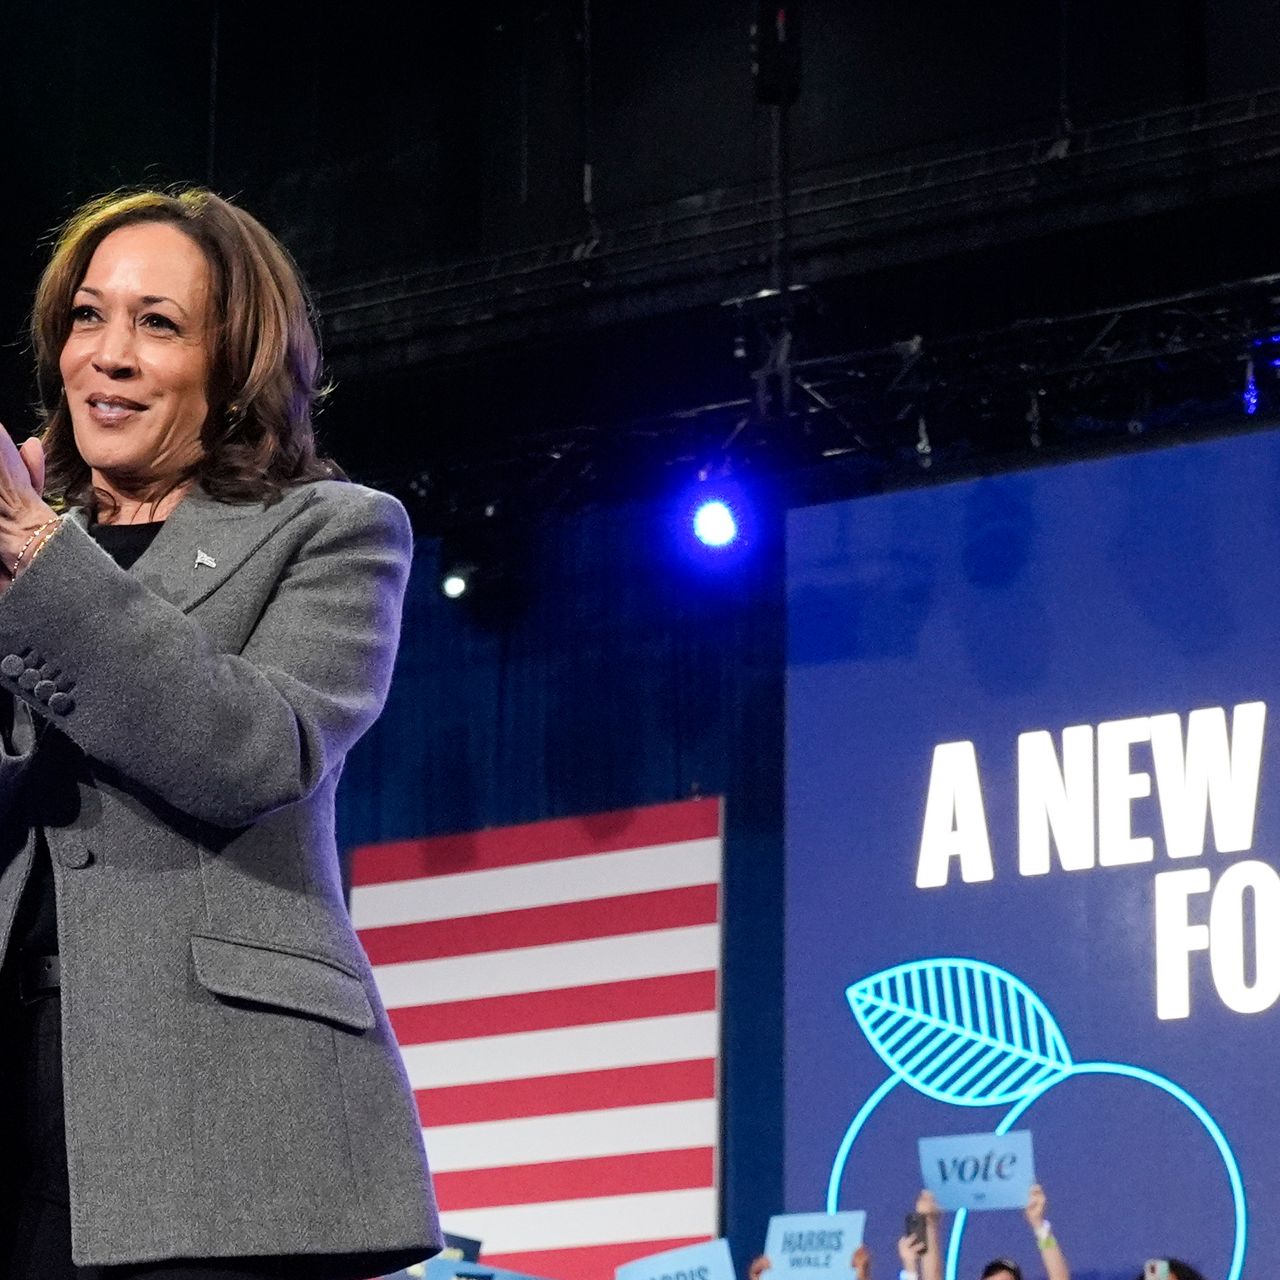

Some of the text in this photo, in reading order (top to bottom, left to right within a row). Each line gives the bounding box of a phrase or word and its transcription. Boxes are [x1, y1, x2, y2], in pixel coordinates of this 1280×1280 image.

[915, 740, 994, 889] A
[1017, 701, 1267, 877] NEW
[937, 1149, 1017, 1184] vote
[781, 1230, 844, 1253] HARRIS
[789, 1254, 832, 1268] WALZ
